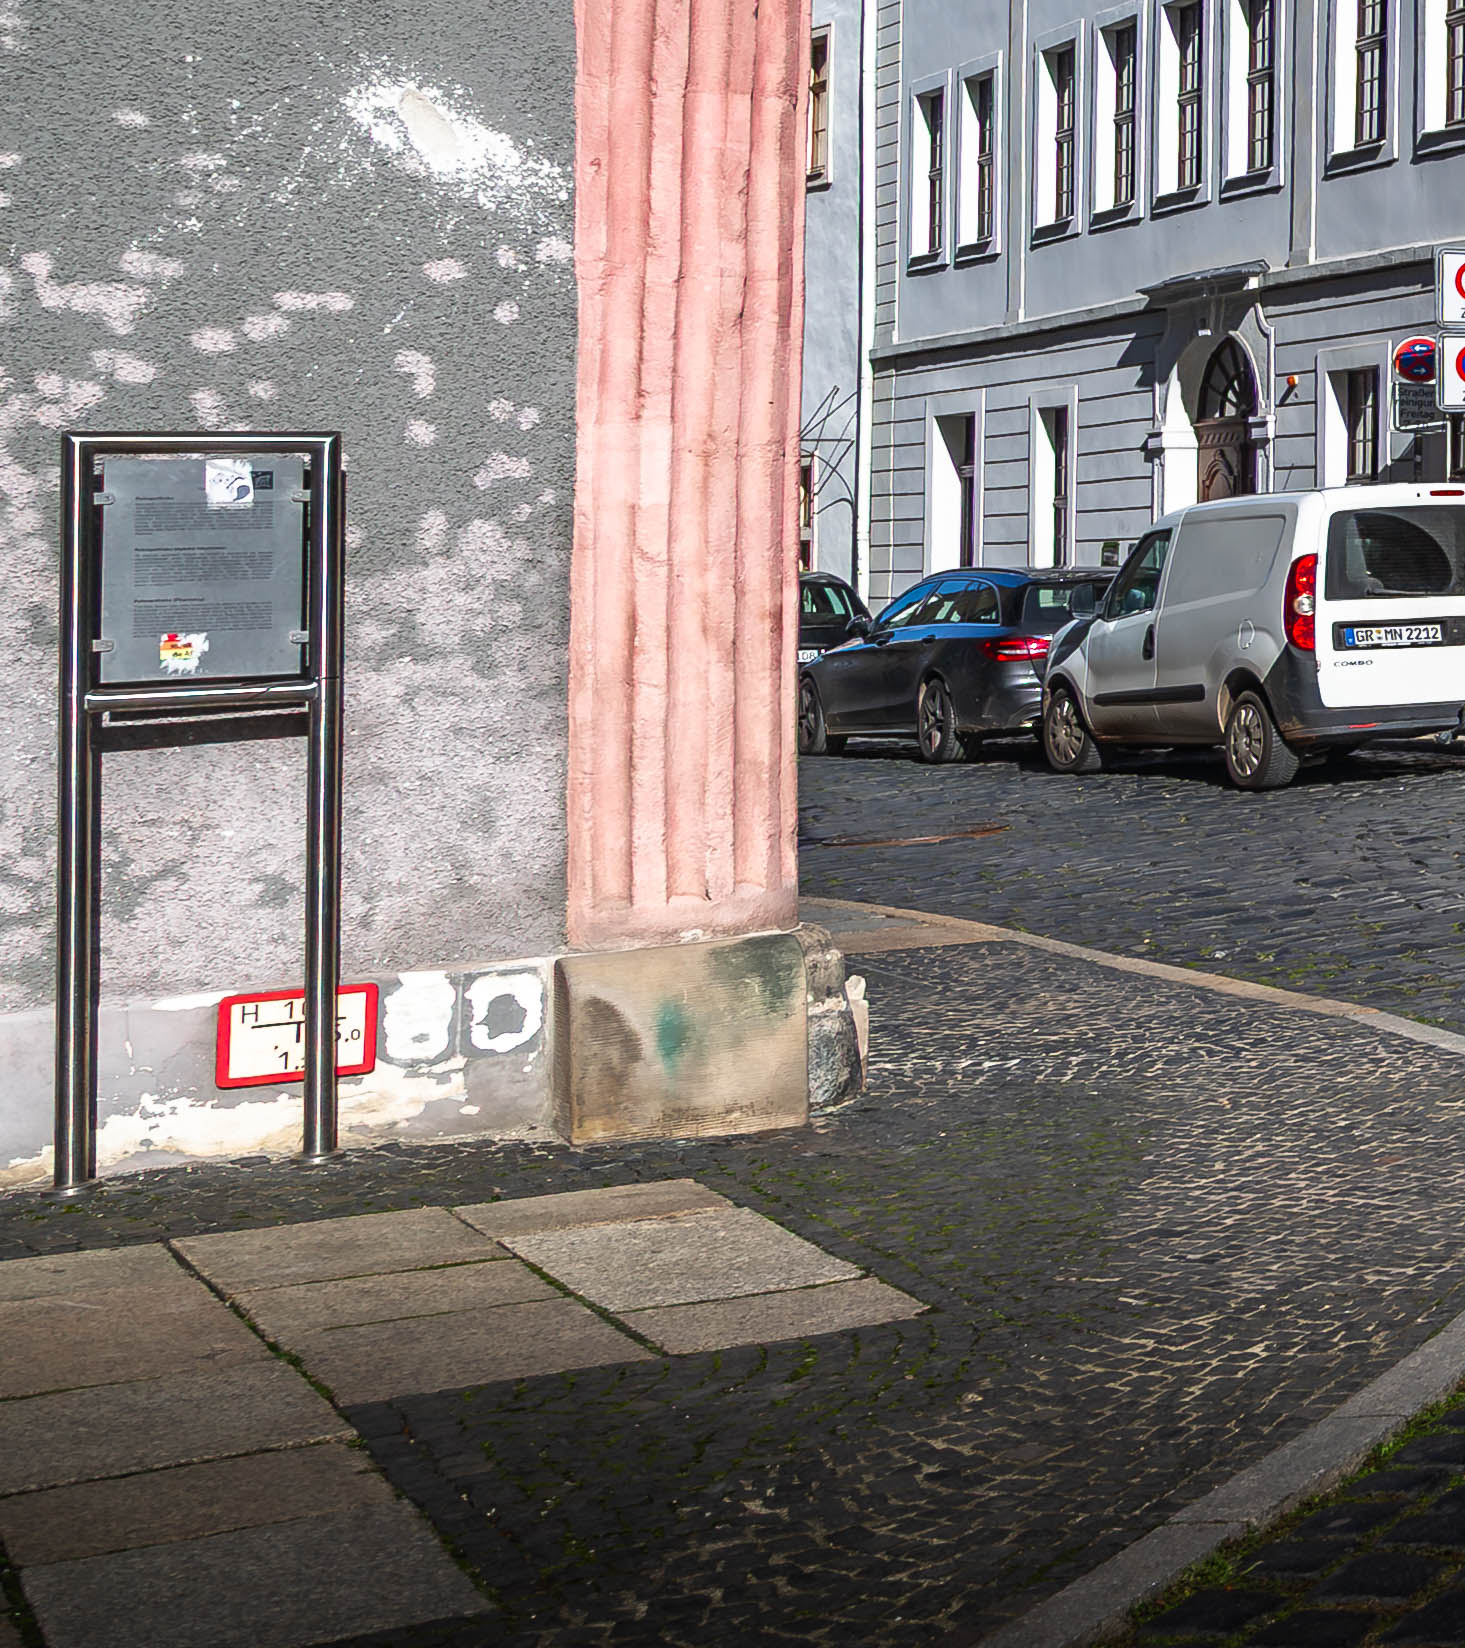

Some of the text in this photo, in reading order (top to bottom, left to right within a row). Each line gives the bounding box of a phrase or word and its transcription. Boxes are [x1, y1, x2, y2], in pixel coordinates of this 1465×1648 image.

[1355, 627, 1439, 643] GR MN 2212
[1333, 659, 1374, 668] COMBO
[241, 1004, 259, 1024] H
